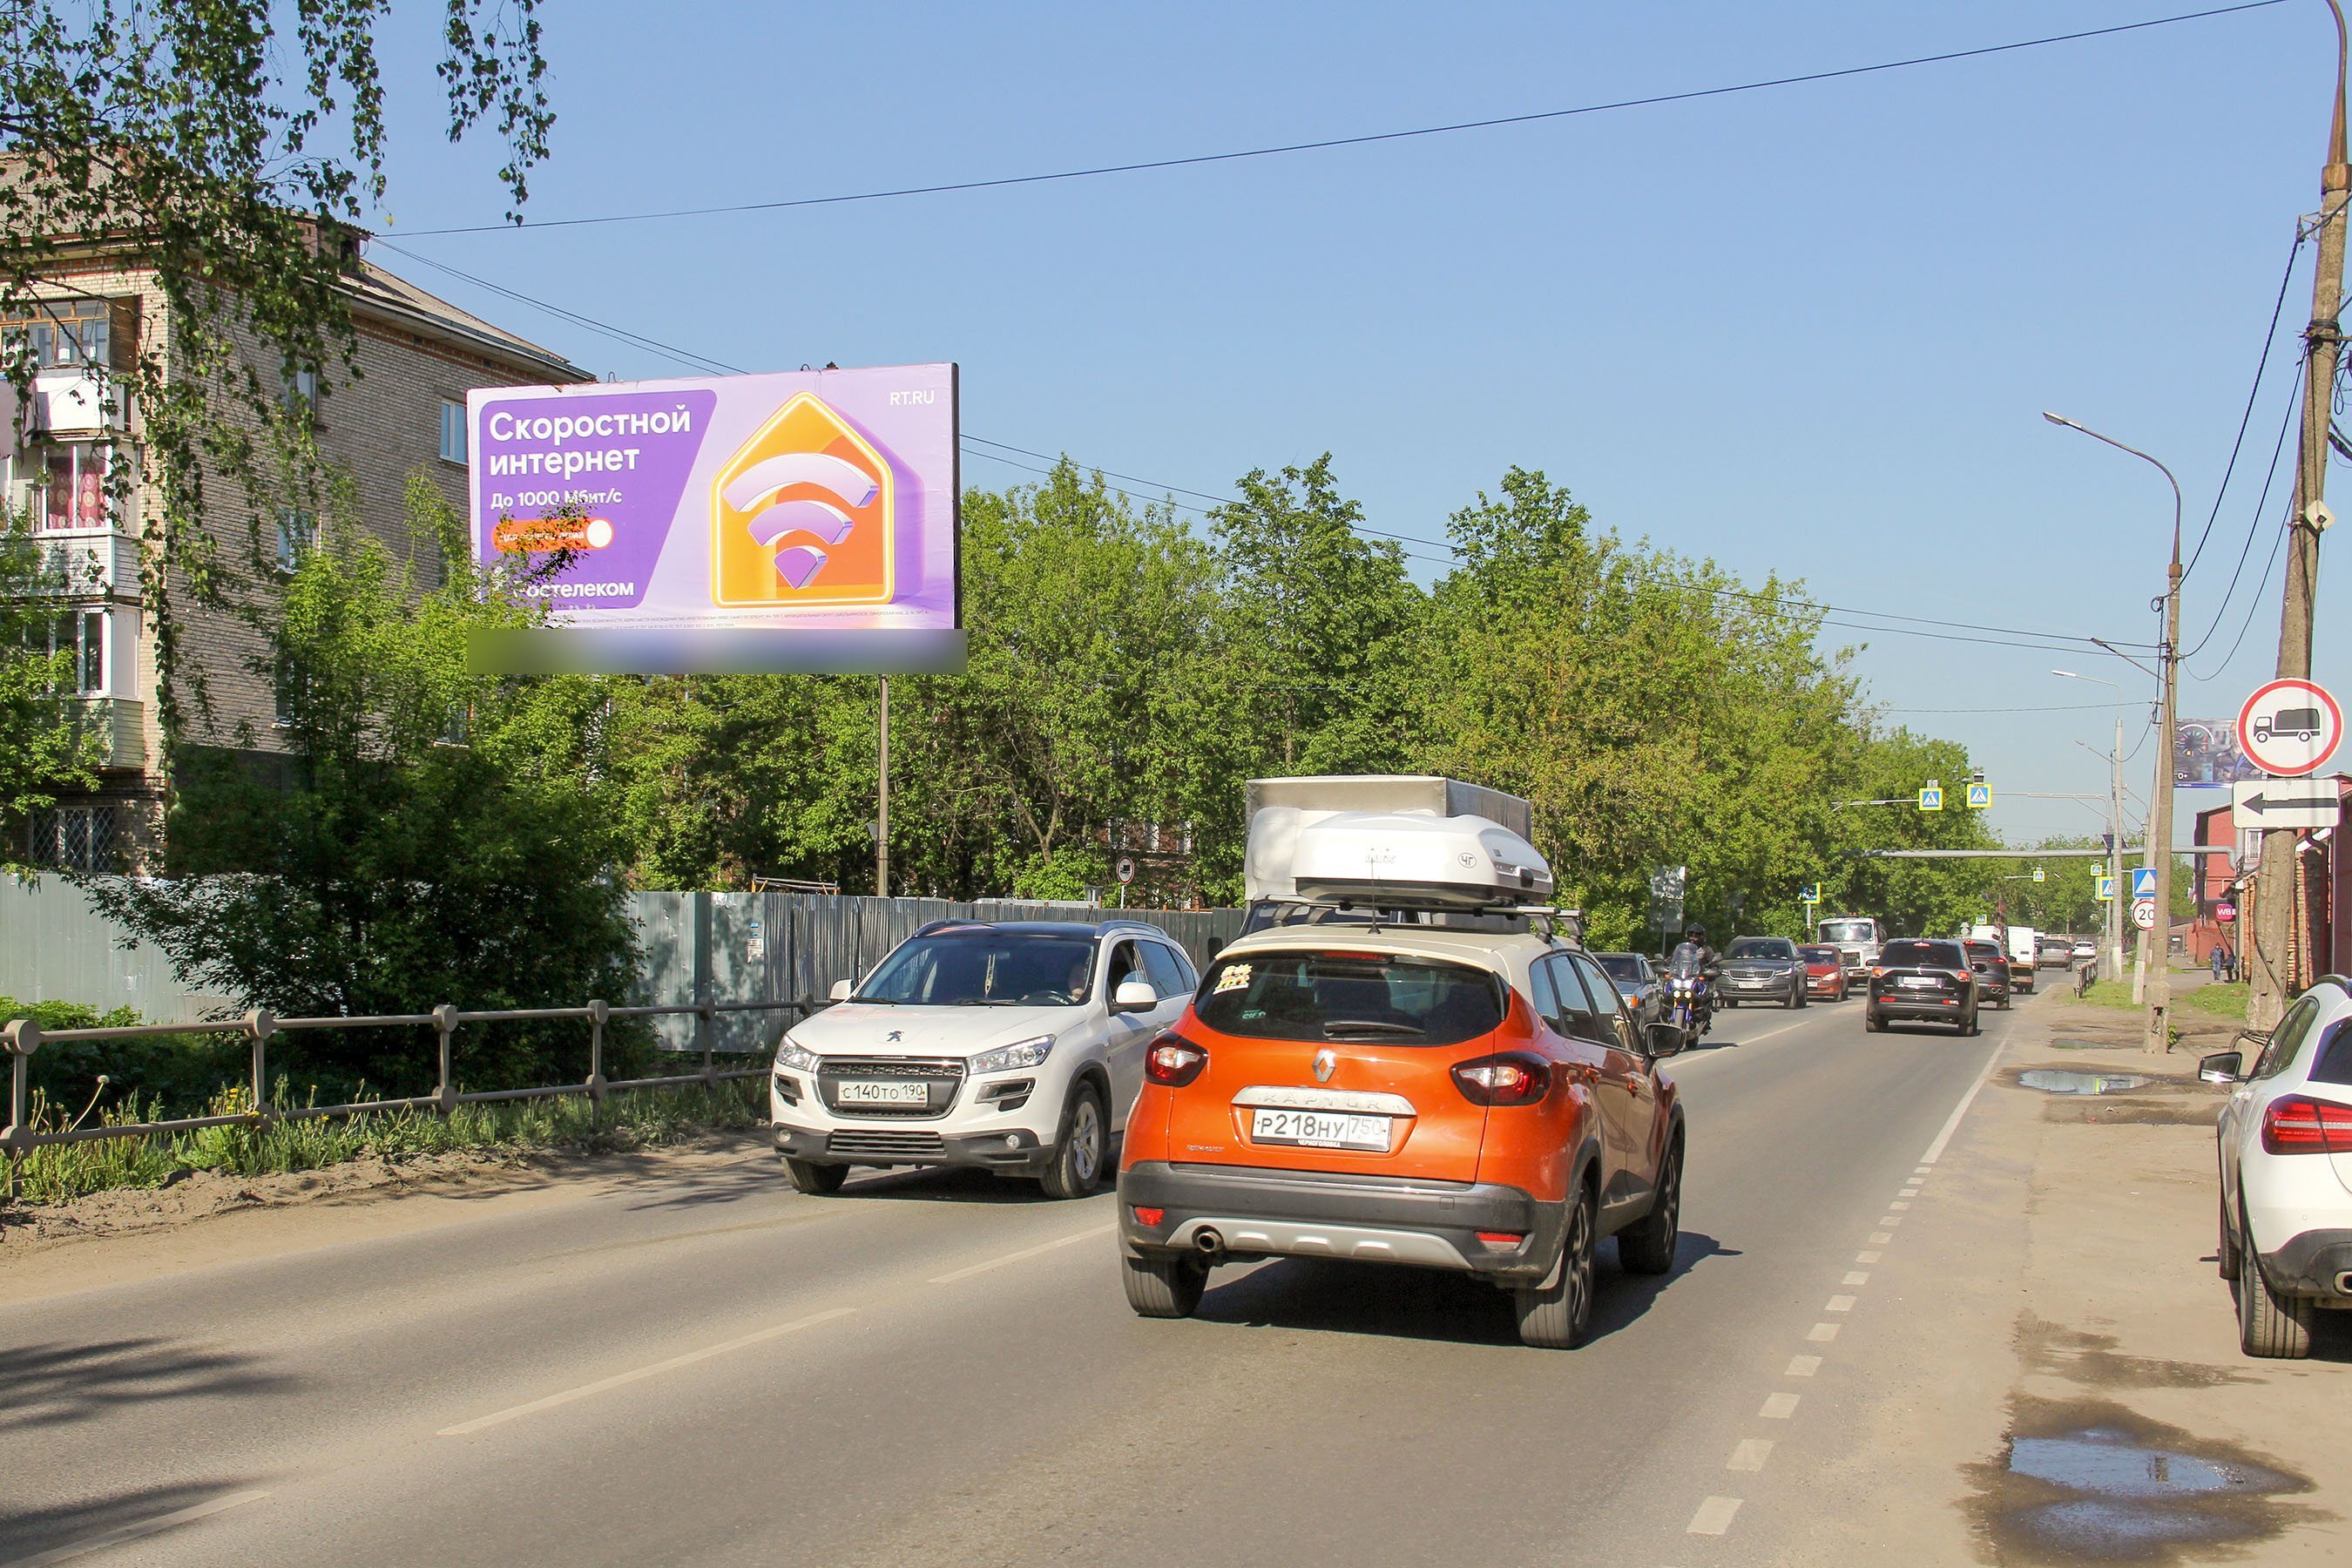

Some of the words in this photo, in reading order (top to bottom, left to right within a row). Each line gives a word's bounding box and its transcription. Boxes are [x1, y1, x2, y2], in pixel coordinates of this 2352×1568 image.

[889, 389, 935, 406] RT.RU
[490, 404, 691, 445] Скоростной
[490, 449, 640, 481] интернет
[490, 492, 514, 510] До
[517, 490, 560, 507] 1000
[564, 487, 623, 504] Мбит/с
[902, 1085, 923, 1096] 190
[1351, 1117, 1383, 1135] 750
